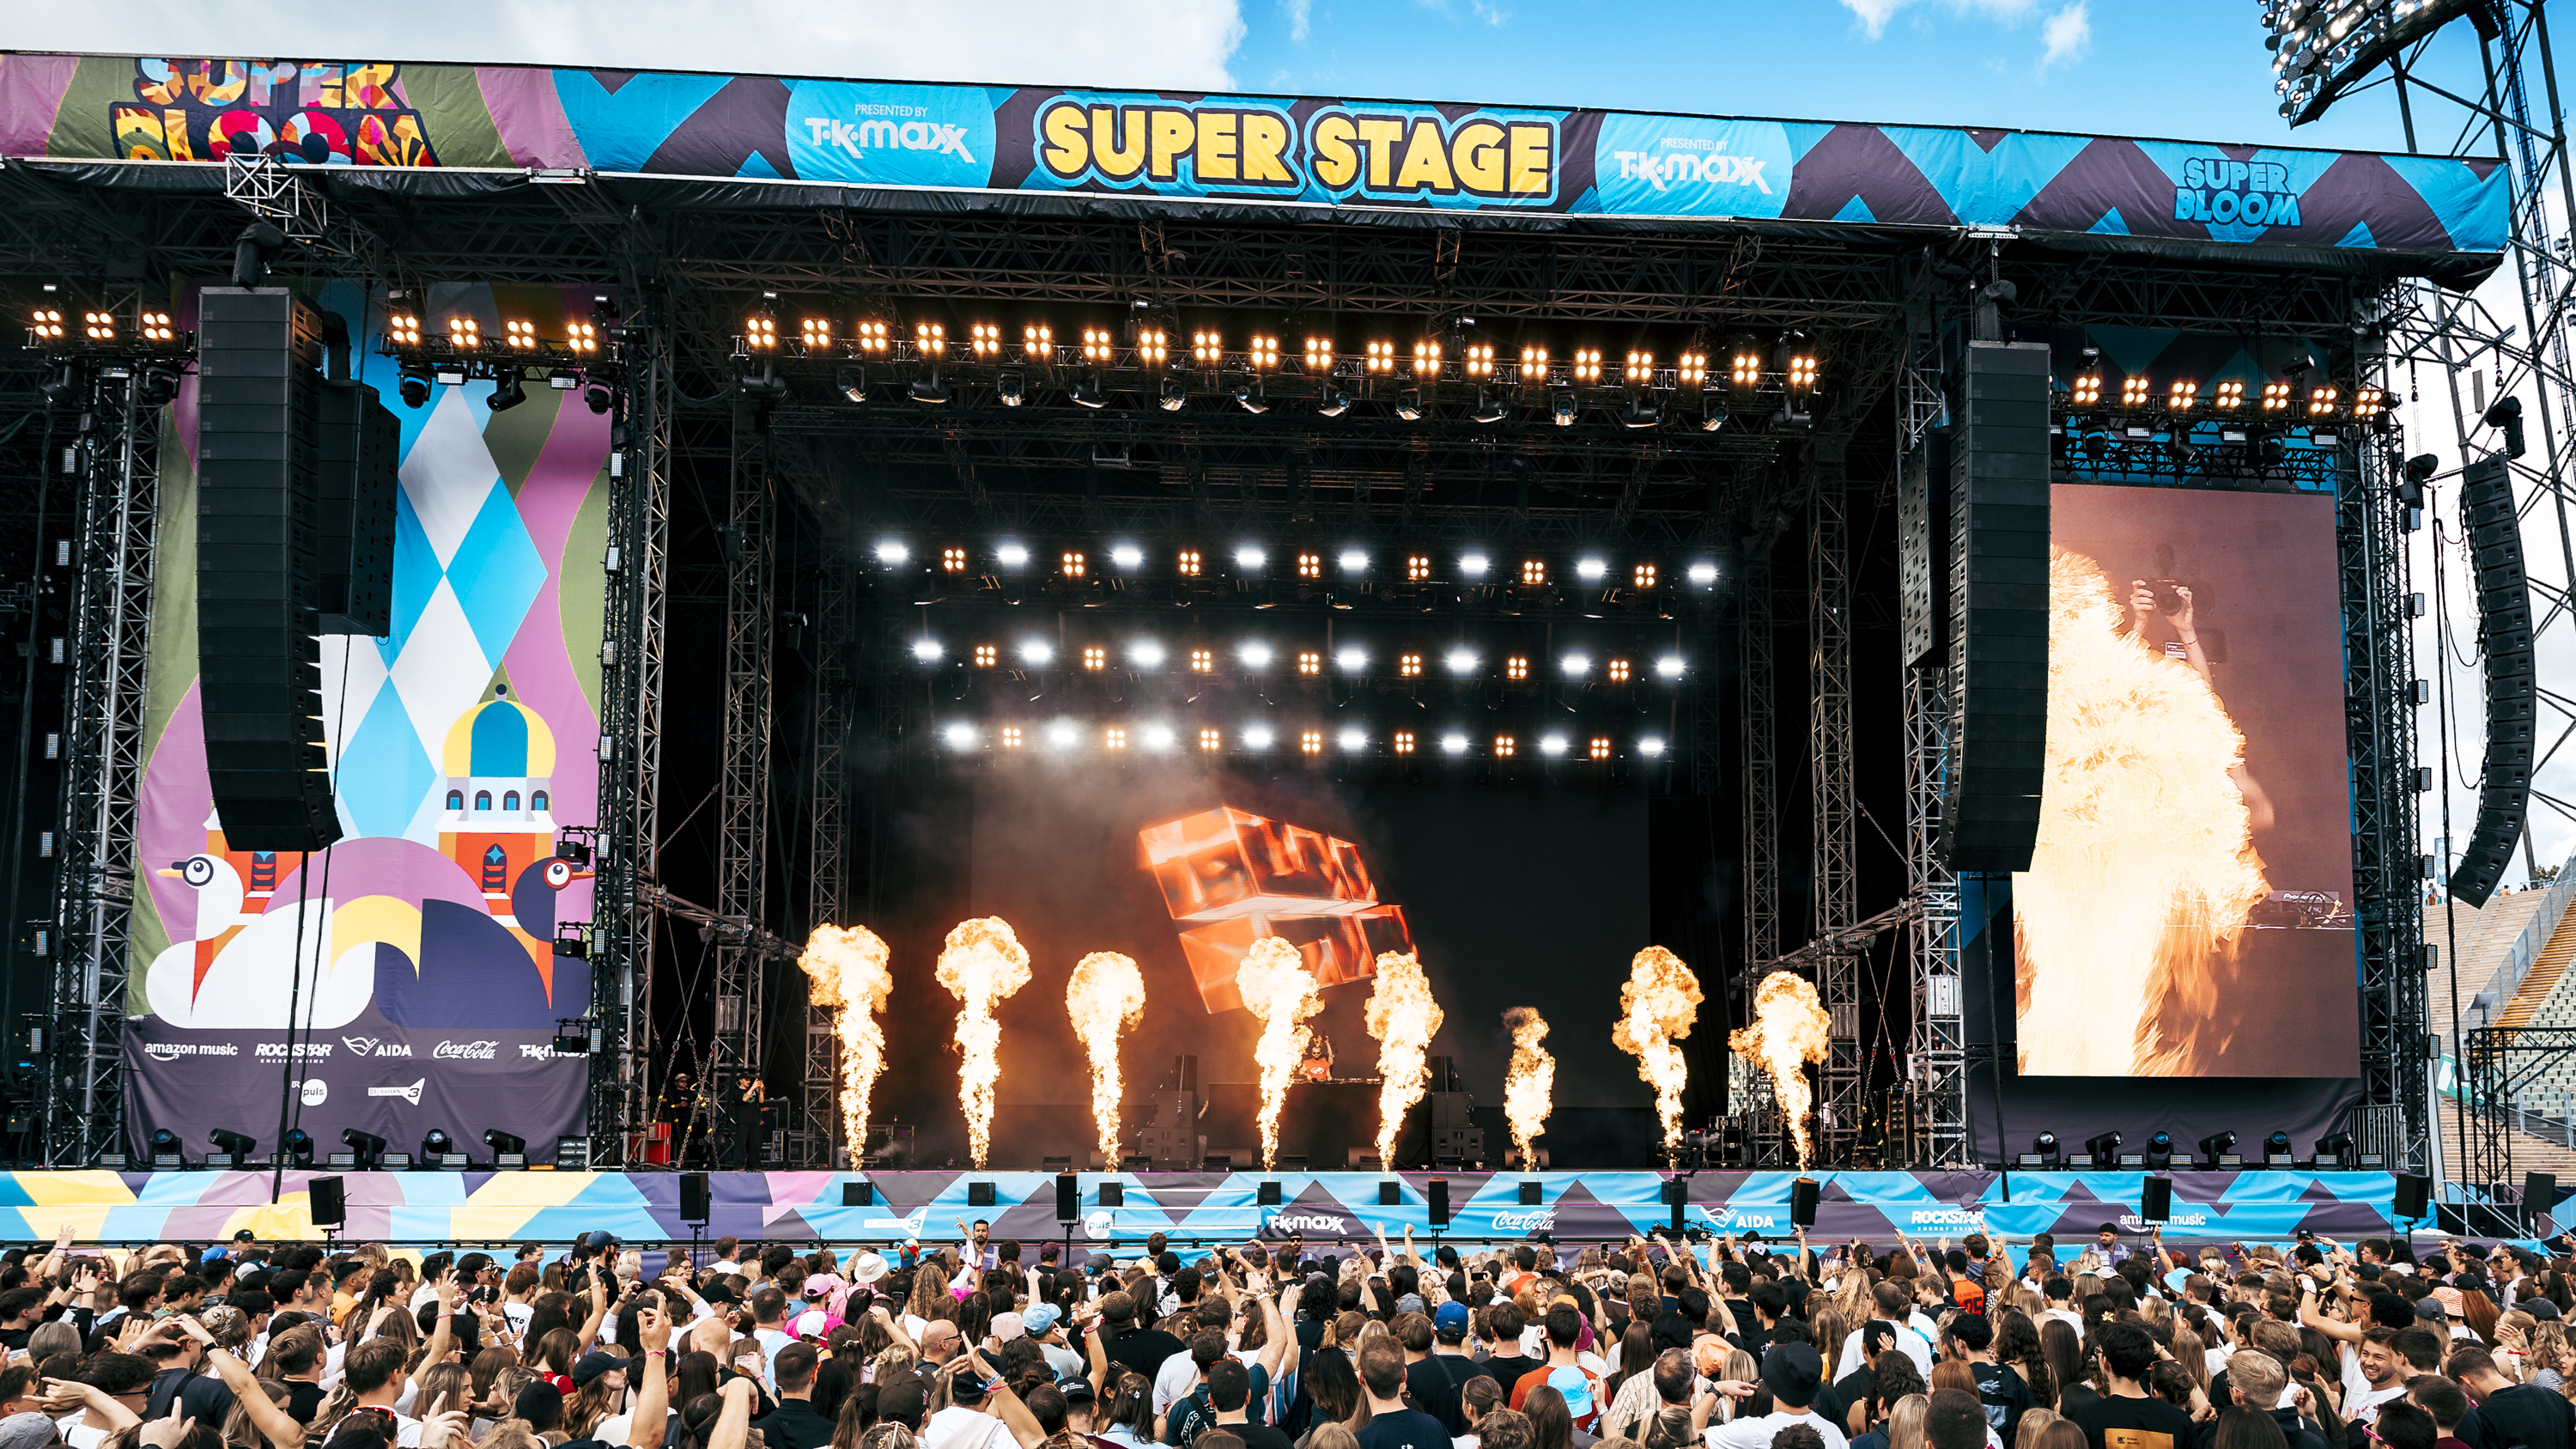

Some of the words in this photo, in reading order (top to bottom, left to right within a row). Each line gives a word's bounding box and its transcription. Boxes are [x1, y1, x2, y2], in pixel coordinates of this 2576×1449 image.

[137, 58, 410, 109] SUPER
[854, 104, 914, 117] PRESENTED
[915, 107, 928, 117] BY
[1045, 106, 1293, 182] SUPER
[1315, 119, 1549, 192] STAGE
[1660, 137, 1713, 150] PRESENTED
[1716, 140, 1728, 150] BY
[2184, 158, 2292, 194] SUPER
[2175, 188, 2301, 226] BLOOM
[144, 1043, 197, 1055] amazon
[199, 1043, 239, 1056] music
[375, 1044, 412, 1056] AIDA
[303, 1087, 324, 1098] puls
[408, 1088, 420, 1098] 3
[1735, 1215, 1775, 1227] AIDA
[1911, 1211, 1984, 1224] ROCKSTAR
[2170, 1213, 2206, 1225] music
[908, 1220, 921, 1229] 3
[1089, 1221, 1110, 1231] puls
